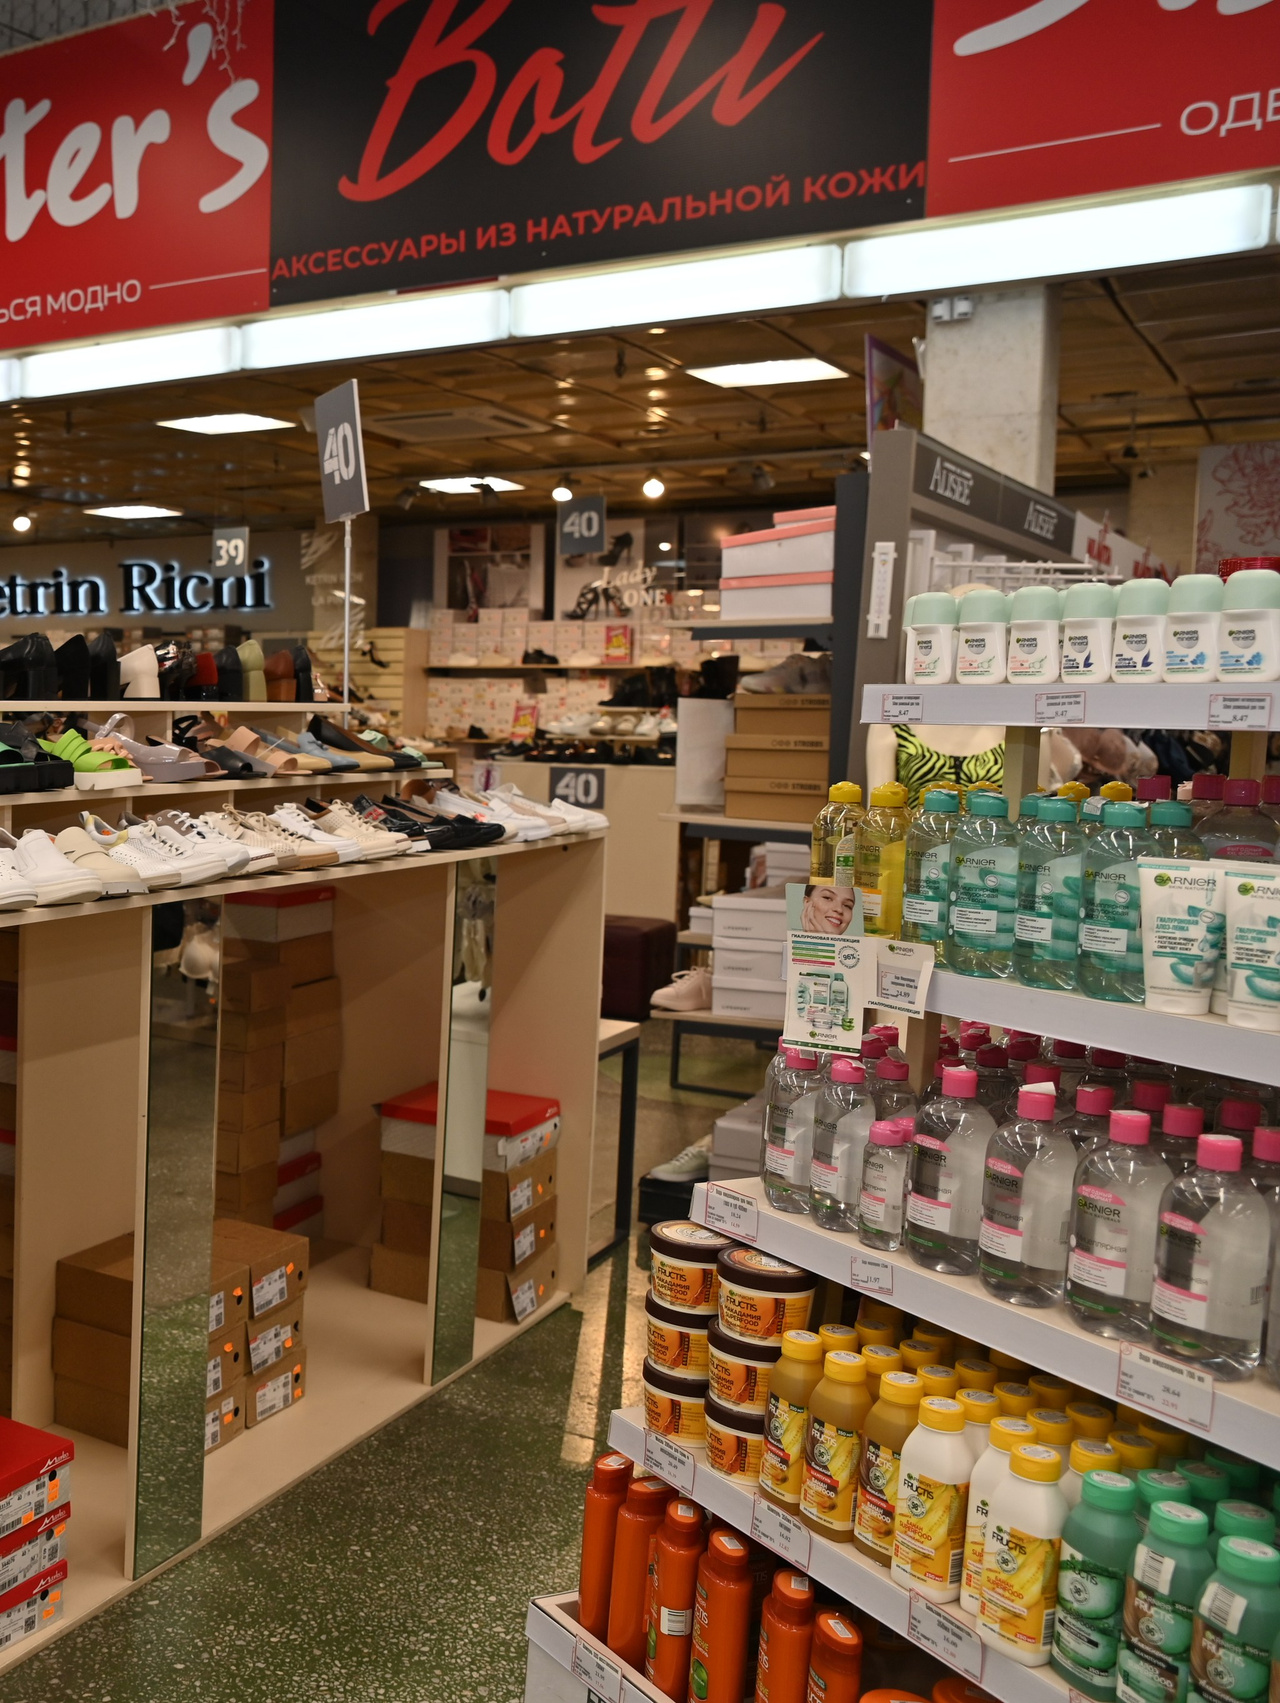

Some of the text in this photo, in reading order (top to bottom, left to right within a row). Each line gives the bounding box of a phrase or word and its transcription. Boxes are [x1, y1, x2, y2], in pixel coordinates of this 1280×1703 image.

[272, 160, 926, 280] АКСЕССУАРЫ ИЗ НАТУРАЛЬНОЙ КОЖИ
[46, 279, 141, 316] МОДНО
[323, 421, 356, 485] 40
[562, 510, 600, 539] 40
[214, 538, 245, 567] 39
[556, 777, 598, 803] 40
[1154, 874, 1216, 887] GARNIER
[1238, 884, 1280, 897] GARNI
[658, 1267, 687, 1282] FRUCTIS
[726, 1295, 758, 1312] FRUCTIS
[39, 1451, 70, 1475] Marko
[903, 1478, 934, 1500] FRUCTIS
[37, 1508, 67, 1533] Marko
[992, 1531, 1027, 1556] FRUCTIS
[33, 1568, 64, 1595] Marko
